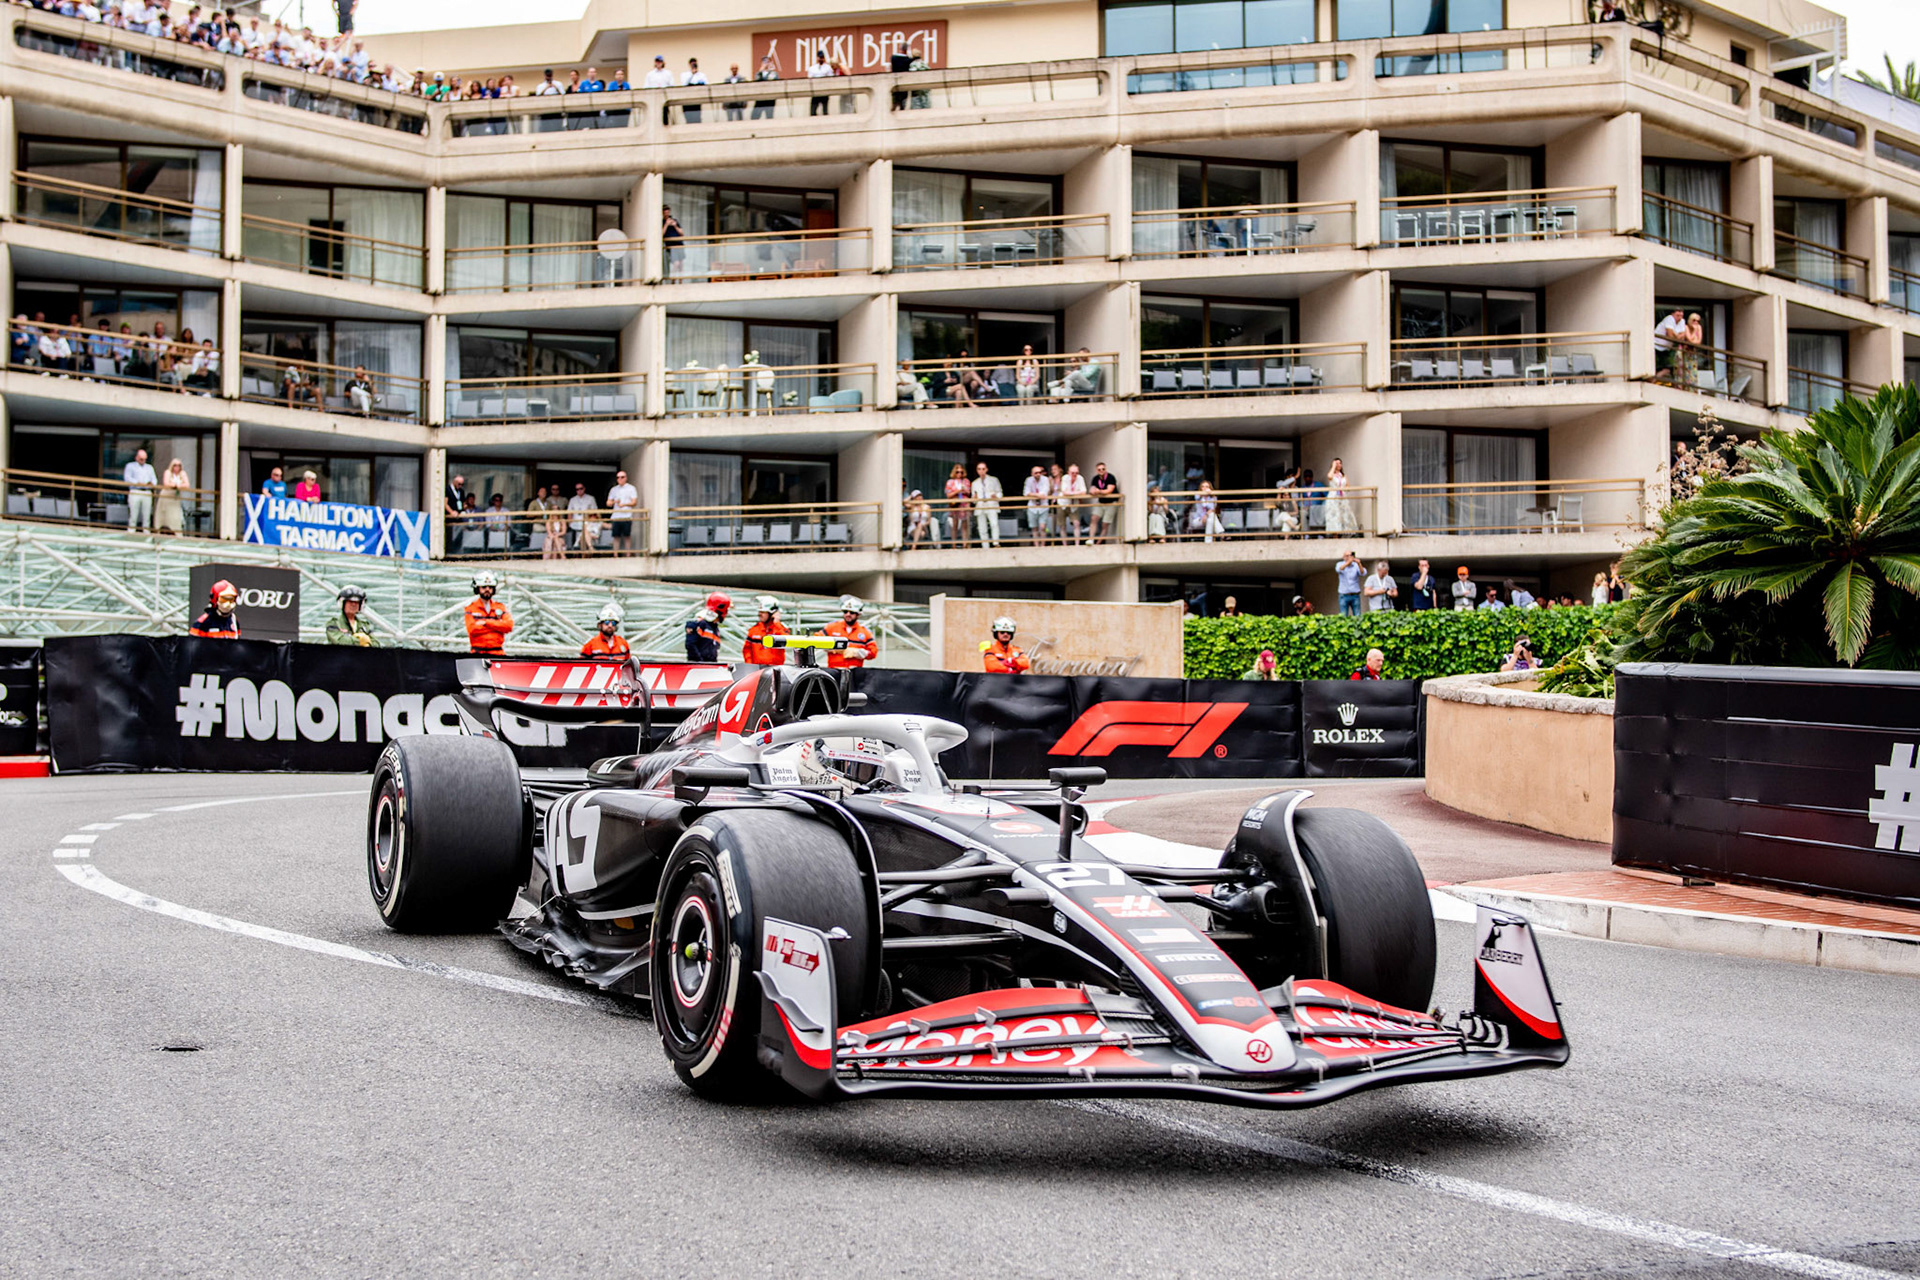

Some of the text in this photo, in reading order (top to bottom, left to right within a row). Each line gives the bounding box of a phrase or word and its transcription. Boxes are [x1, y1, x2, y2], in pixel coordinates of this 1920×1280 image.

[796, 35, 853, 72] NIKKI
[268, 498, 374, 529] HAMILTON
[276, 524, 366, 553] TARMAC
[1313, 729, 1385, 744] ROLEX
[772, 767, 793, 775] Palm
[772, 775, 798, 783] Angels
[1035, 862, 1126, 889] 27
